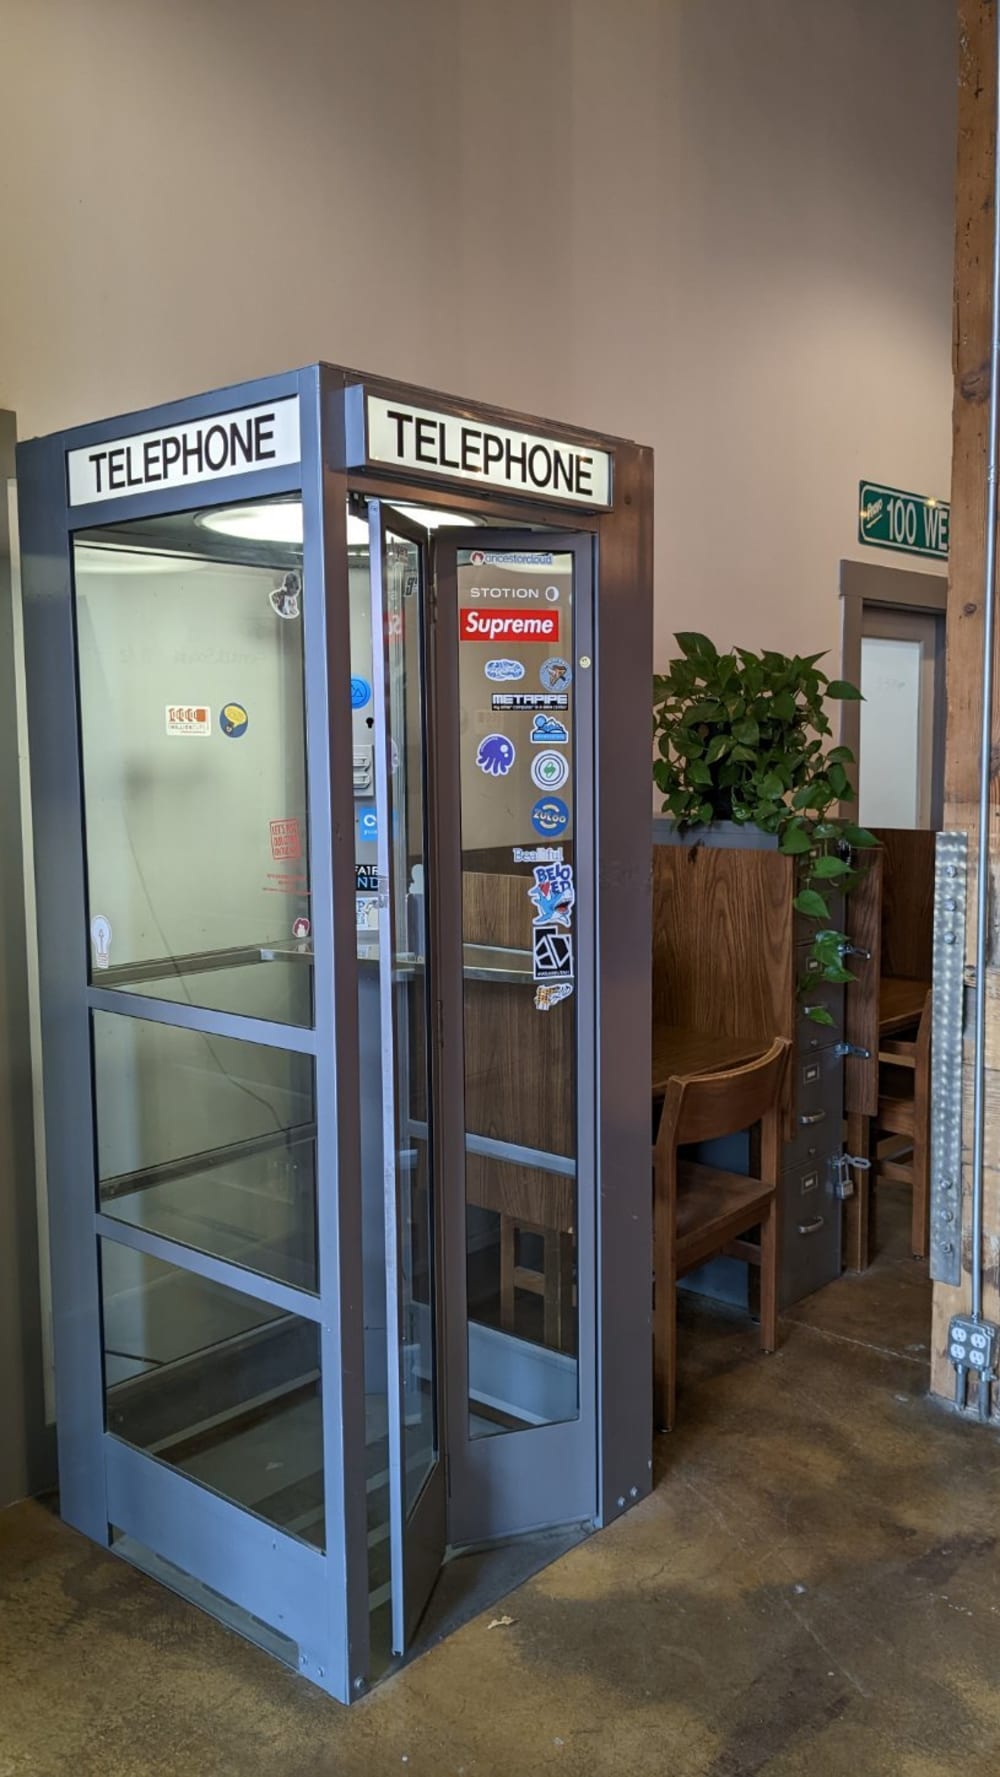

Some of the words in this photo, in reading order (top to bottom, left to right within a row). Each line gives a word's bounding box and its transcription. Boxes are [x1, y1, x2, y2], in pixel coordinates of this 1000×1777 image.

[88, 412, 276, 494] TELEPHONE
[386, 409, 594, 497] TELEPHONE
[886, 498, 917, 545] 100
[923, 505, 948, 551] WE
[466, 611, 554, 639] Supreme
